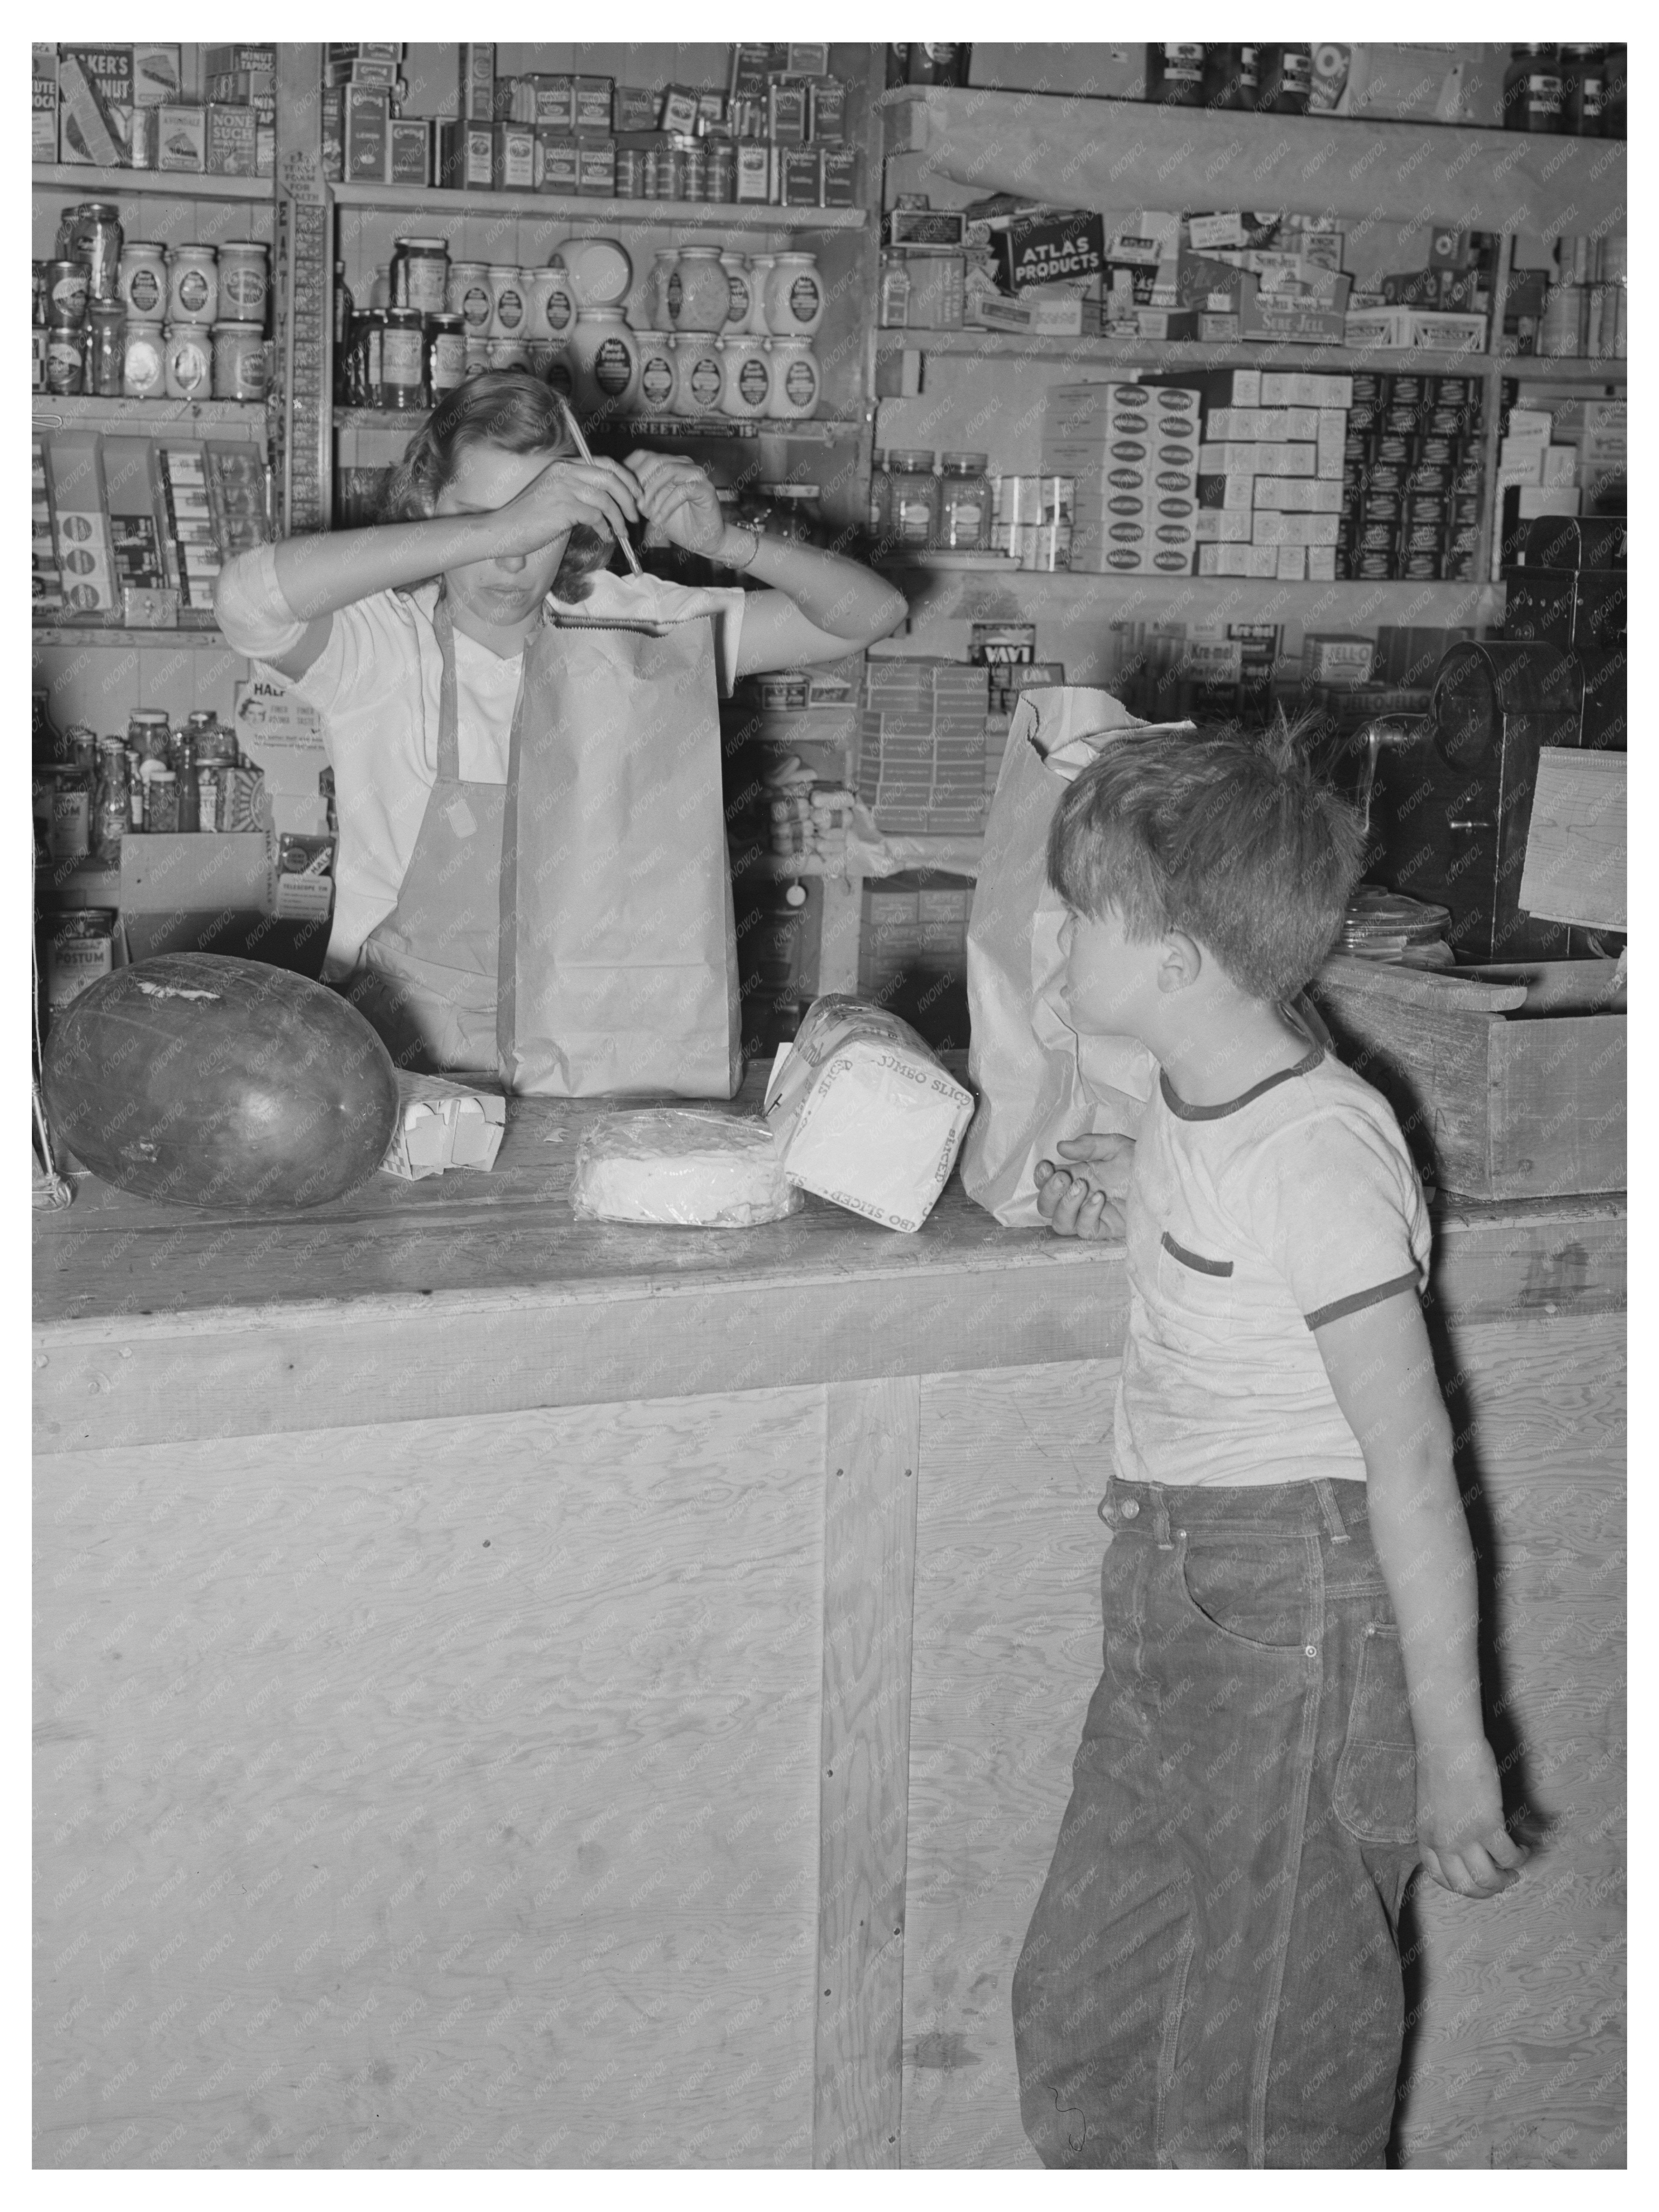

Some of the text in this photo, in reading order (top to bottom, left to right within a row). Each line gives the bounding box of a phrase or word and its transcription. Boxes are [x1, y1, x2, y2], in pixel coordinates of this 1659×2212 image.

[240, 51, 273, 62] MINUT
[67, 54, 128, 75] KER'S
[240, 61, 274, 72] TAPIOC
[32, 80, 56, 94] UTE
[213, 115, 254, 128] NONE
[213, 128, 253, 140] SUCH
[295, 193, 319, 201] ALTH
[1022, 236, 1090, 264] ATLAS
[1015, 252, 1100, 281] PRODUCTS
[56, 953, 104, 963] POSTUM
[934, 1128, 956, 1184] SLICED
[831, 1191, 885, 1219] SLICED
